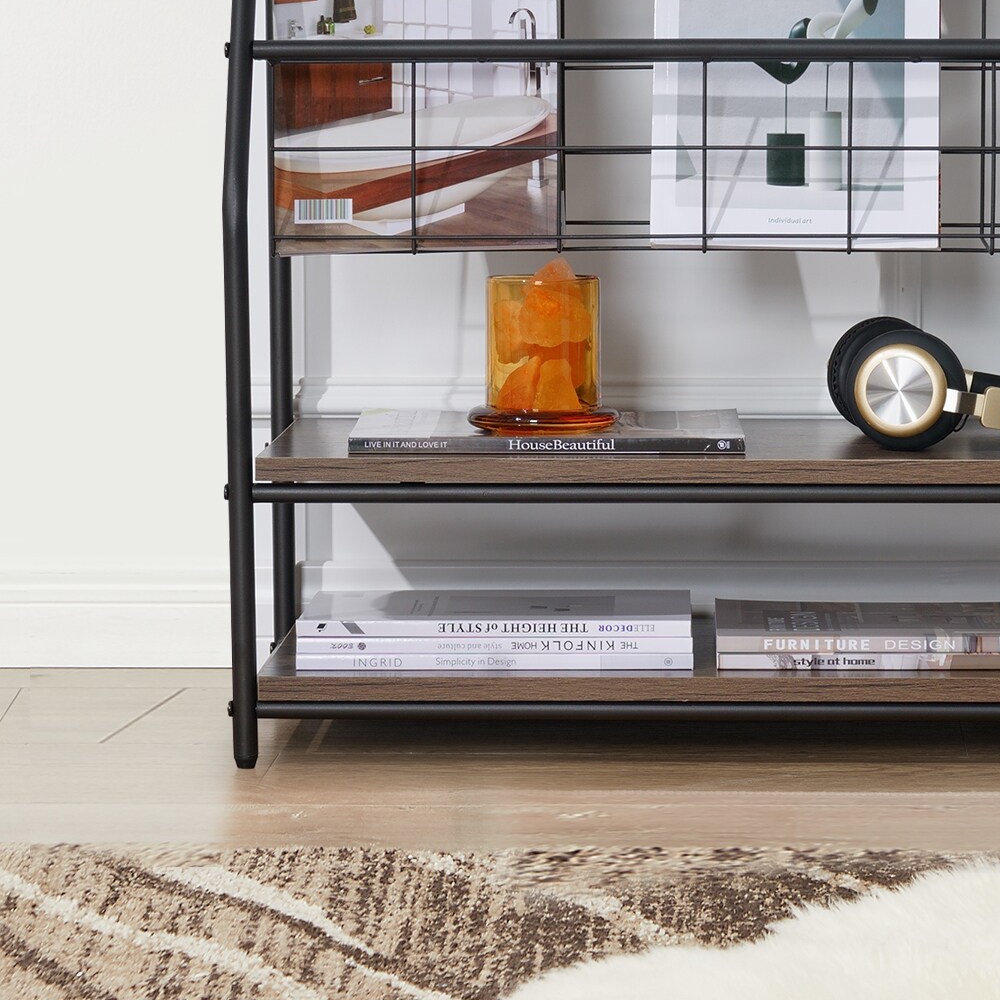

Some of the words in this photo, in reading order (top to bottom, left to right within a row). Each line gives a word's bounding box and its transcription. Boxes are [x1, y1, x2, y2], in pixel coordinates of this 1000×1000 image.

[508, 438, 616, 452] HouseBeautiful
[438, 623, 482, 633] STYLE
[485, 622, 498, 633] of
[501, 622, 557, 633] HEIGHT
[560, 623, 588, 633] THE
[467, 642, 482, 650] and
[483, 642, 502, 651] style
[511, 642, 537, 650] HOME
[541, 640, 615, 651] KINFOLK
[763, 639, 870, 650] FURNITURE
[884, 639, 956, 650] DESIGN
[353, 658, 403, 668] INGRID
[435, 657, 475, 667] Simplicity
[487, 657, 516, 667] Design
[793, 657, 825, 667] style
[843, 657, 875, 665] home
